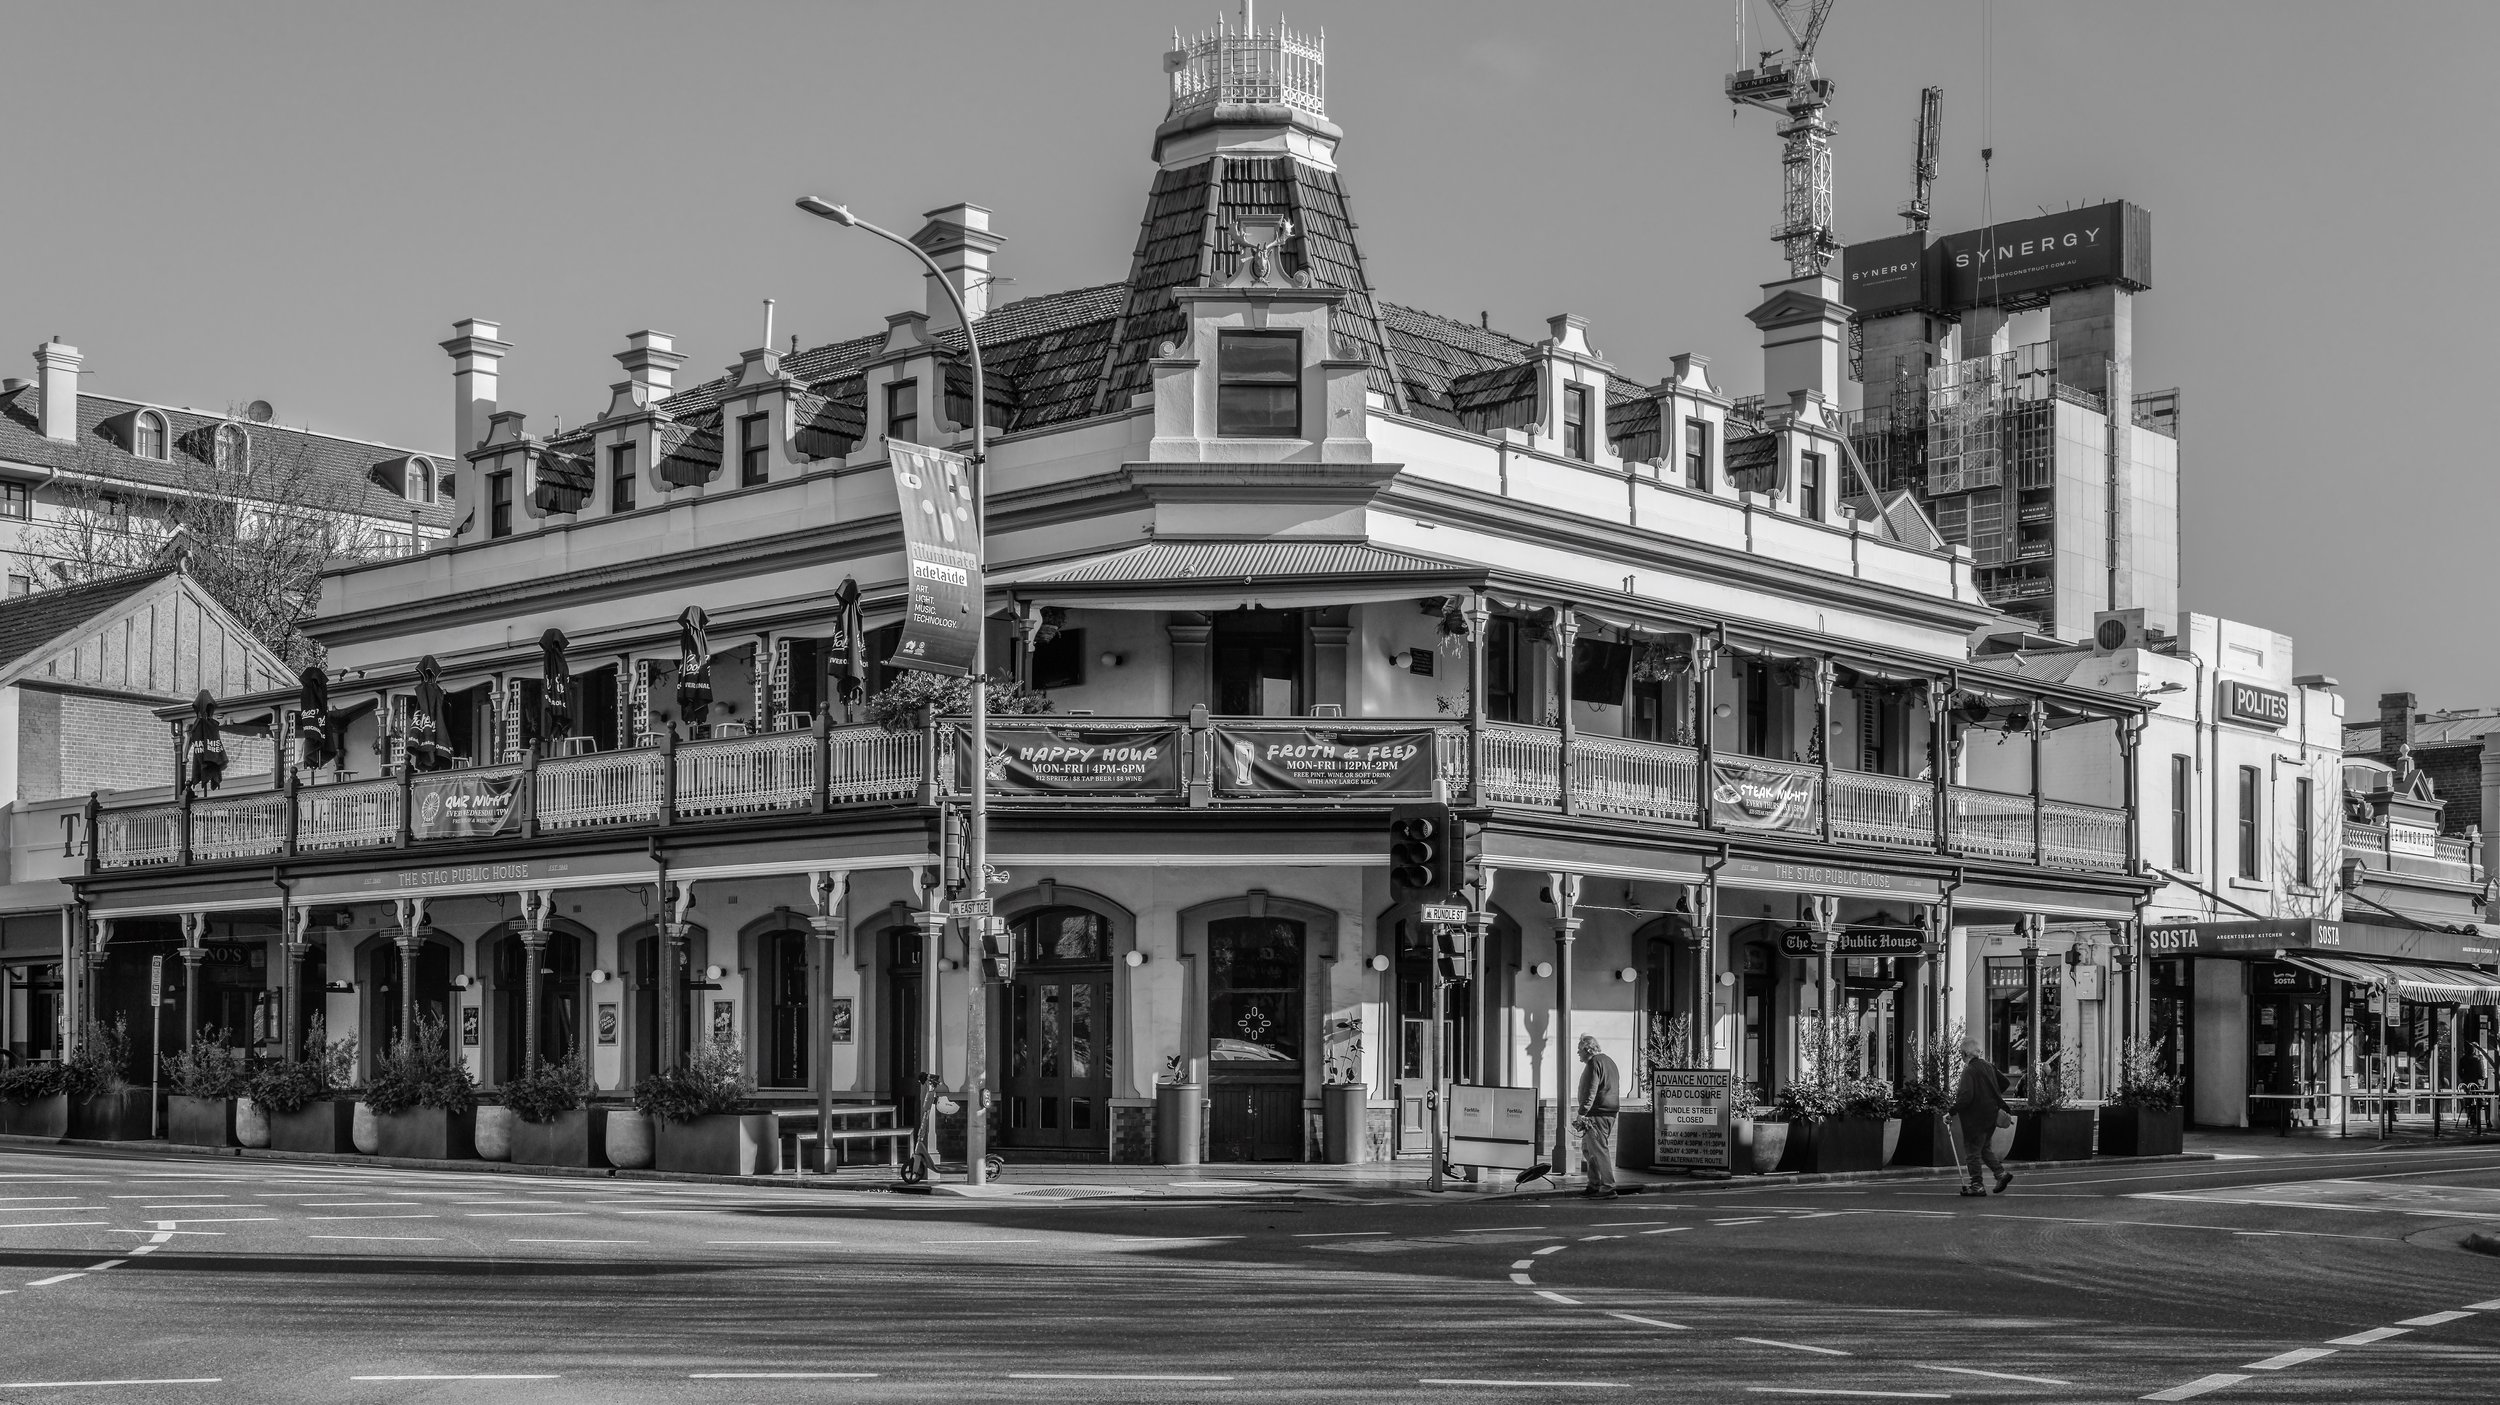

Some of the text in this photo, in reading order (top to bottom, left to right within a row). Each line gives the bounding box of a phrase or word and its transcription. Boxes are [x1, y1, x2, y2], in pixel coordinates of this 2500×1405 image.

[1955, 227, 2100, 268] SYNERGY
[1852, 261, 1918, 281] SYNERGY
[915, 565, 966, 585] adelaide
[915, 584, 929, 594] ART.
[915, 594, 935, 605] LIGHT.
[914, 603, 937, 615] MUSIC.
[913, 613, 957, 629] TECHNOLOGY.
[2237, 688, 2287, 719] POLITES
[1019, 746, 1158, 763] HAPPY HOUR
[1266, 744, 1418, 761] FROTH & FEED
[1032, 764, 1145, 773] MON-FRI 4PM-6PM
[1286, 760, 1398, 770] MON-FRI 12PM-2PM
[1740, 784, 1808, 803] STEAK NIGHT
[1764, 801, 1791, 811] THURSAY
[2391, 828, 2434, 847] LEMONGRASS
[398, 864, 529, 886] THE STAG PUBLIC HOUSE
[1774, 864, 1793, 880] THE
[1797, 866, 1822, 882] STAG
[1825, 868, 1859, 885] PUBLIC
[1861, 872, 1890, 888] HOUSE
[961, 902, 988, 914] EAST TCE
[1433, 909, 1464, 920] RUNDLE ST
[1786, 935, 1809, 951] The
[1839, 935, 1878, 950] Public
[1879, 934, 1918, 950] House
[2150, 929, 2199, 949] SOSTA
[2318, 925, 2340, 946] SOSTA
[1656, 1074, 1728, 1086] ADVANCE NOTICE
[1660, 1090, 1721, 1099] ROAD CLOSURE
[1664, 1106, 1690, 1114] RUNDLE
